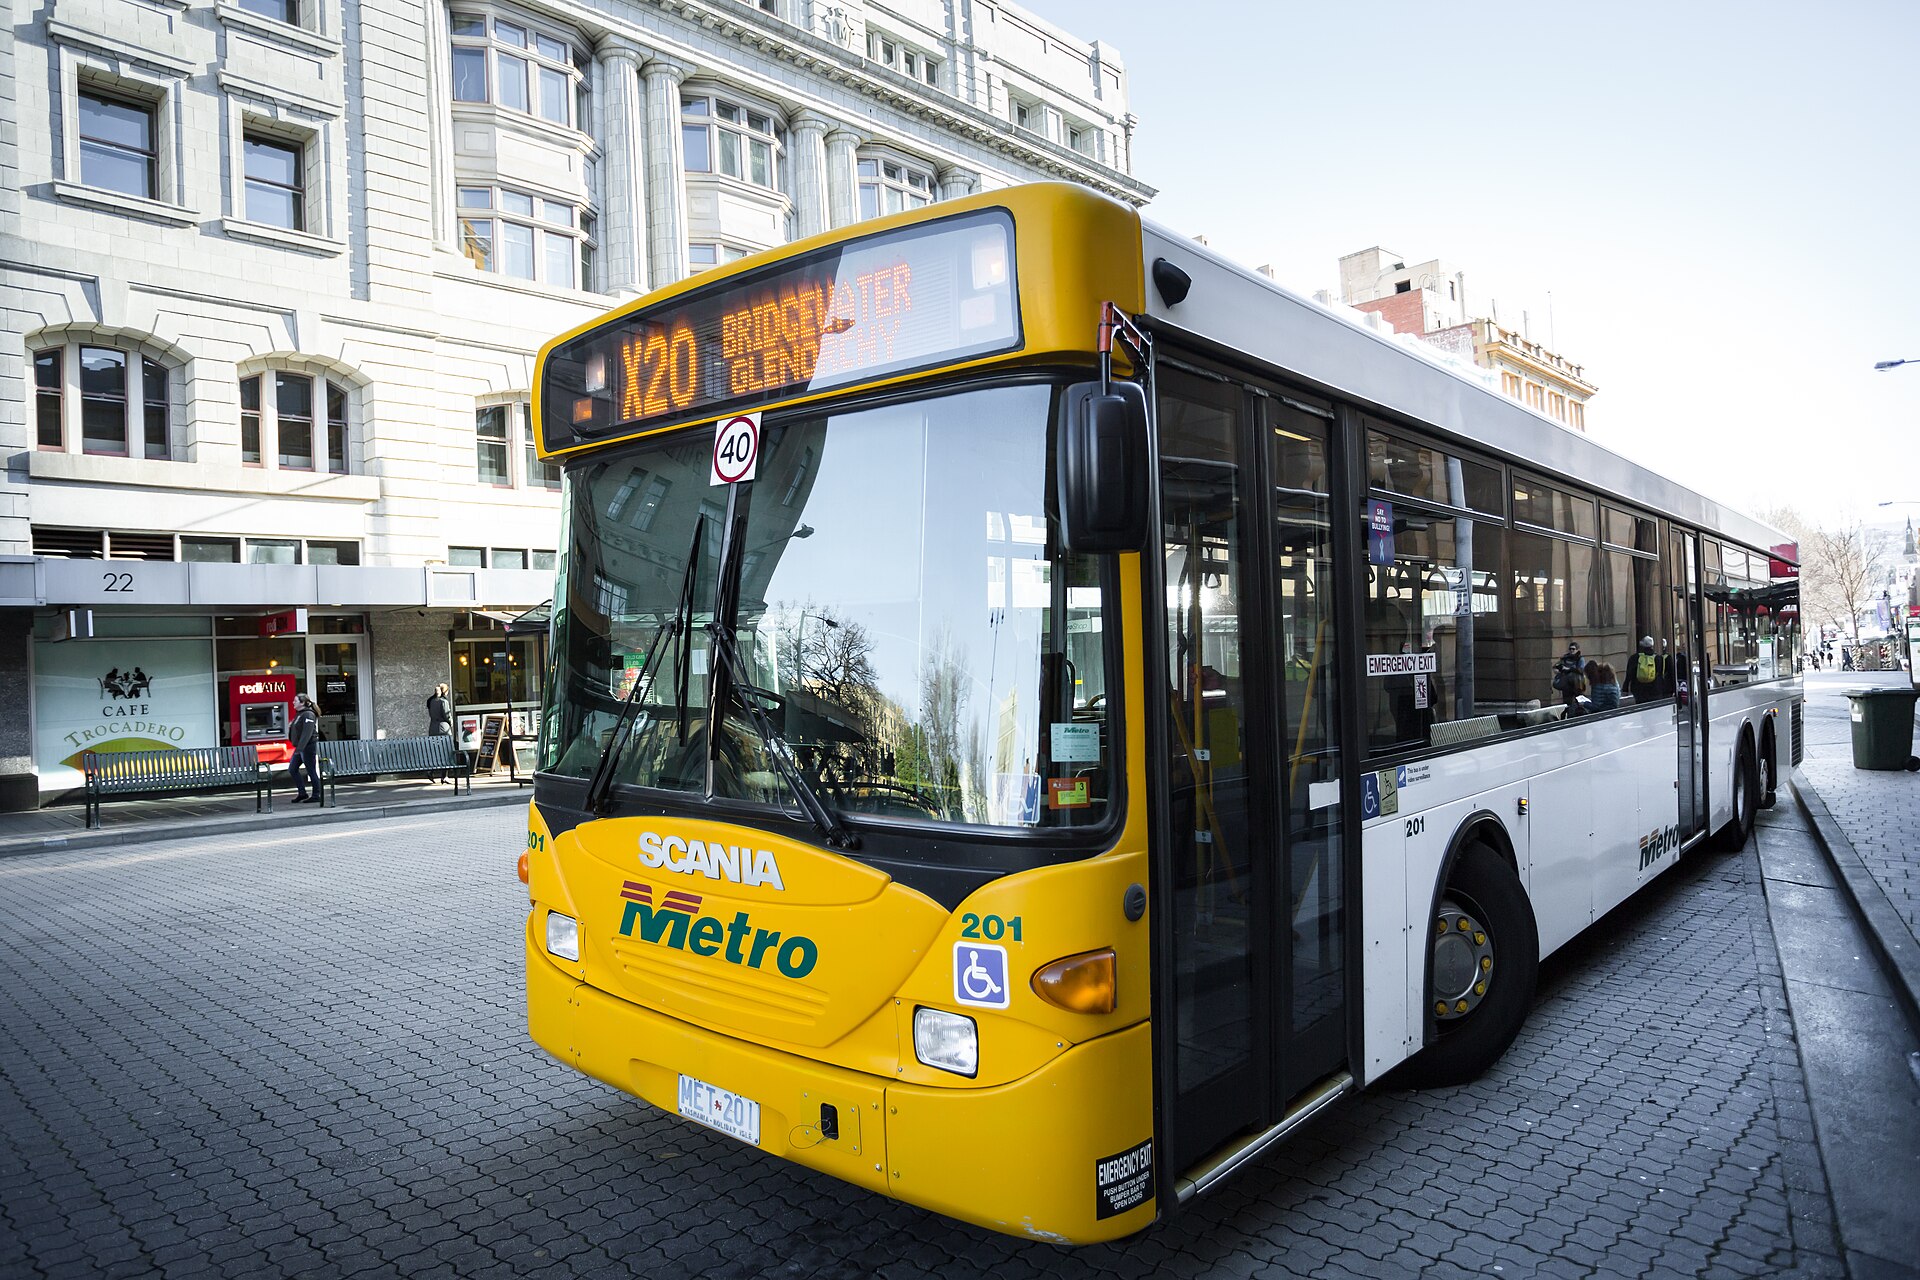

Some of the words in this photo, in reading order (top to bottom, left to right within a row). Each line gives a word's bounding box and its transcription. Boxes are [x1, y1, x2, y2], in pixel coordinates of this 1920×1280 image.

[622, 327, 697, 420] X20
[722, 263, 912, 358] BRIDGEWATER
[720, 432, 750, 464] 40
[103, 573, 134, 592] 22
[1369, 656, 1416, 673] EMERGENCY
[1419, 655, 1434, 671] EXIT
[103, 704, 149, 717] CAFE
[64, 721, 185, 748] TROCADERO
[1406, 816, 1425, 837] 201
[638, 832, 785, 891] SCANIA
[1639, 824, 1680, 872] Metro
[619, 880, 818, 979] Metro
[962, 913, 1022, 941] 201
[681, 1076, 715, 1116] MET
[723, 1093, 753, 1131] 201
[684, 1106, 709, 1123] TASMANIA
[1098, 1150, 1139, 1186] EMERGENCY
[1140, 1143, 1151, 1169] EXIT
[1103, 1186, 1117, 1197] PUSH
[1118, 1178, 1135, 1192] BUTTON
[1135, 1171, 1150, 1184] UNDER
[1109, 1190, 1130, 1204] BUMPER
[1130, 1185, 1139, 1197] BAR
[1140, 1181, 1146, 1191] TO
[1114, 1199, 1127, 1210] OPEN
[1128, 1191, 1143, 1204] DOORS
